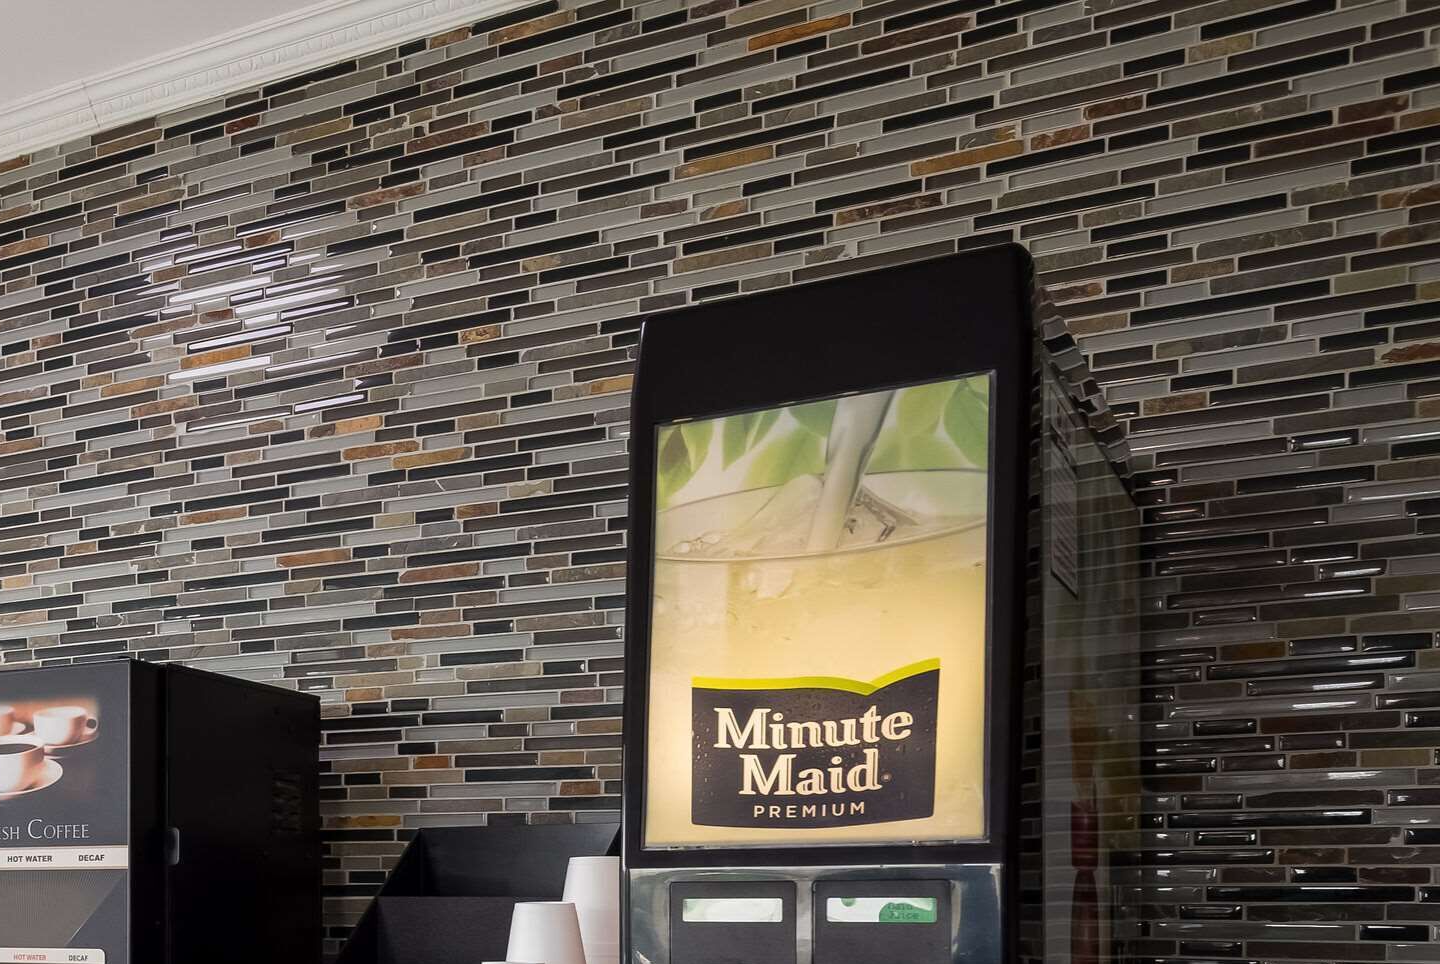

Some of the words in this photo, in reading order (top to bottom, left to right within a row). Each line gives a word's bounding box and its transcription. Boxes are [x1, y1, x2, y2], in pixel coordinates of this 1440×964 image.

[713, 705, 914, 750] Minute
[738, 748, 883, 796] Maid
[753, 801, 865, 819] PREMIUM
[7, 855, 24, 863] HOT
[25, 855, 53, 863] WATER
[78, 853, 105, 862] DECAF
[13, 953, 27, 961] HOT
[68, 954, 89, 962] DECAF
